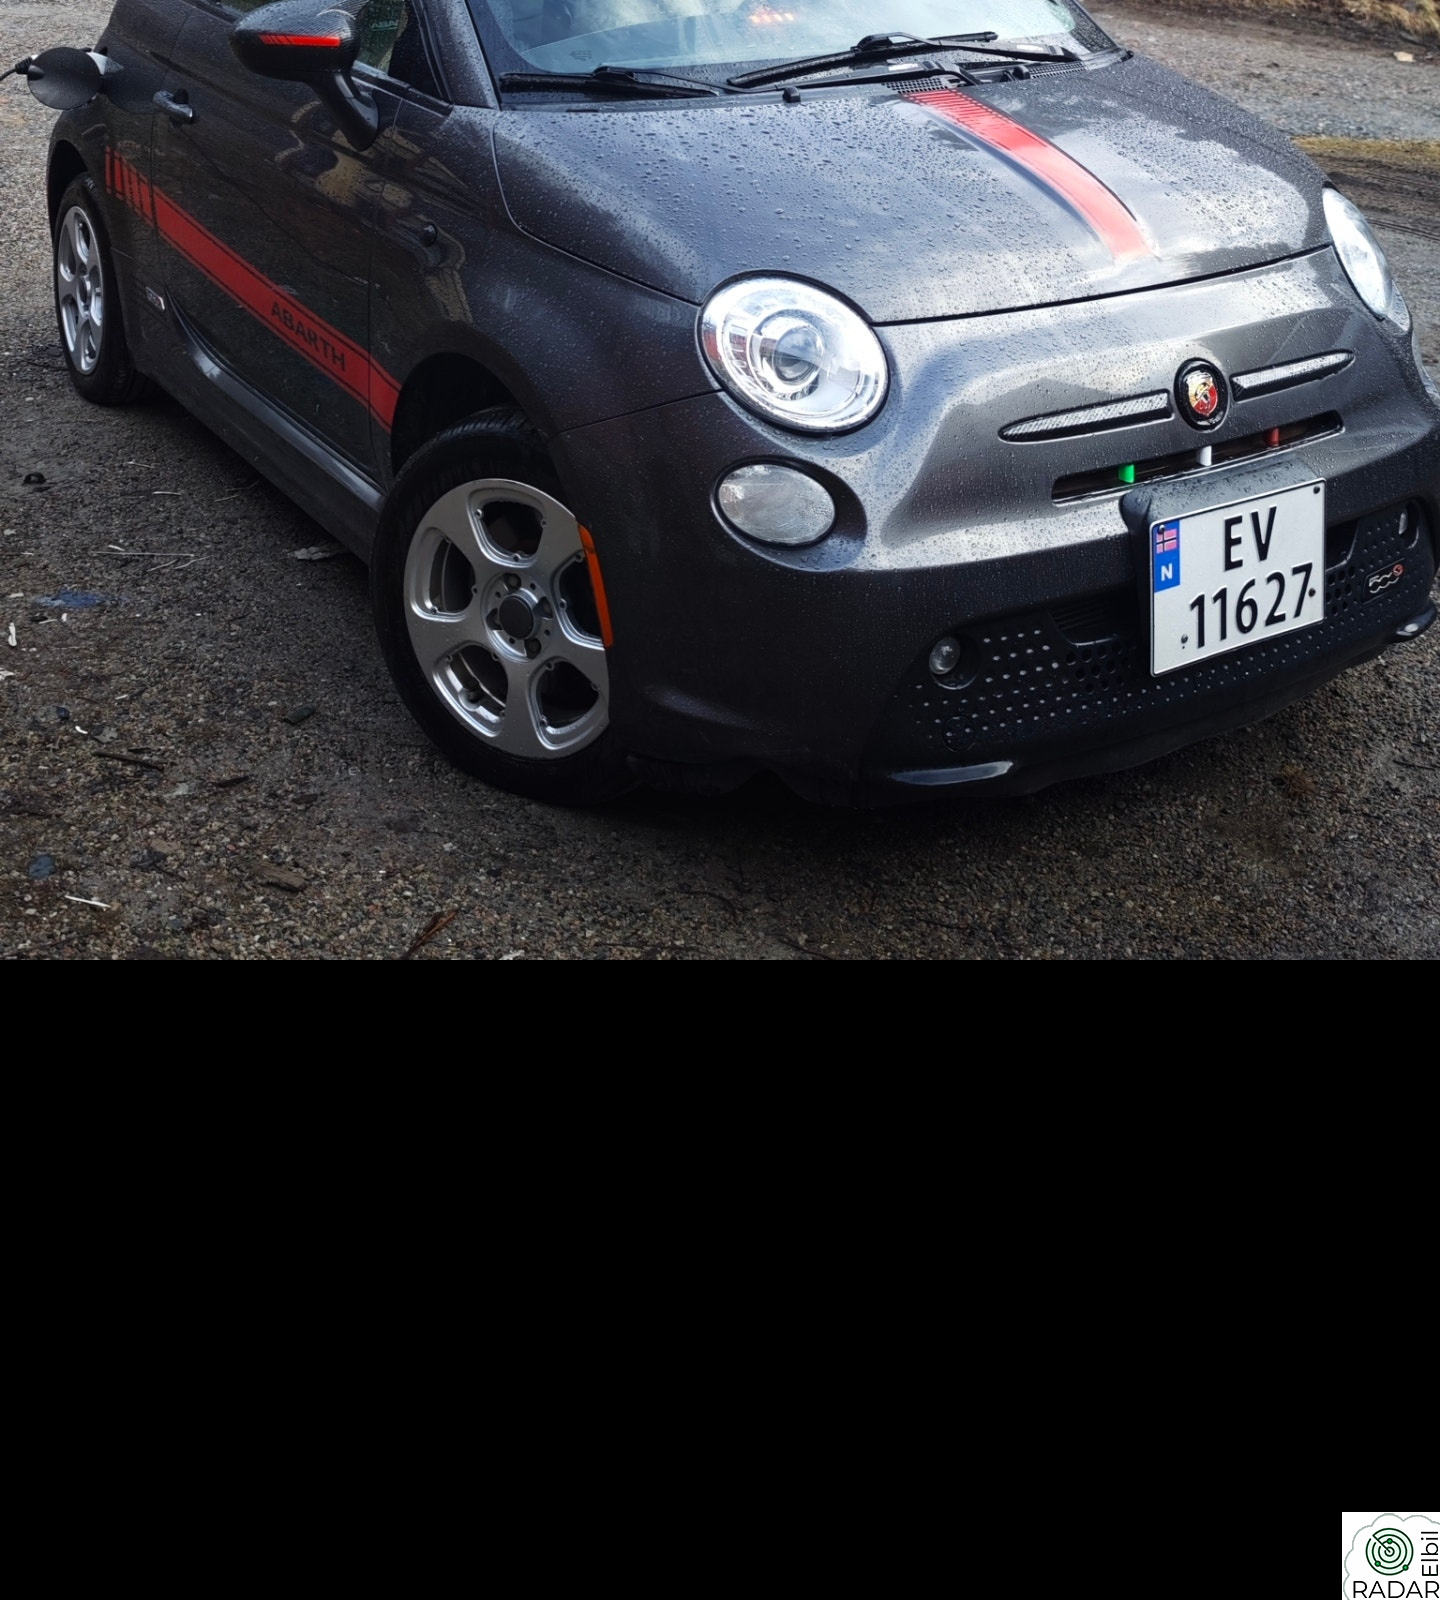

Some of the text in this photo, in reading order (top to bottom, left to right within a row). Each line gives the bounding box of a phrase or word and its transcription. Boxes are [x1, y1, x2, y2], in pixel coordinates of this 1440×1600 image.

[271, 301, 346, 373] ABARTH
[1161, 562, 1173, 582] N
[1223, 505, 1278, 572] EV
[1189, 561, 1313, 649] 11627
